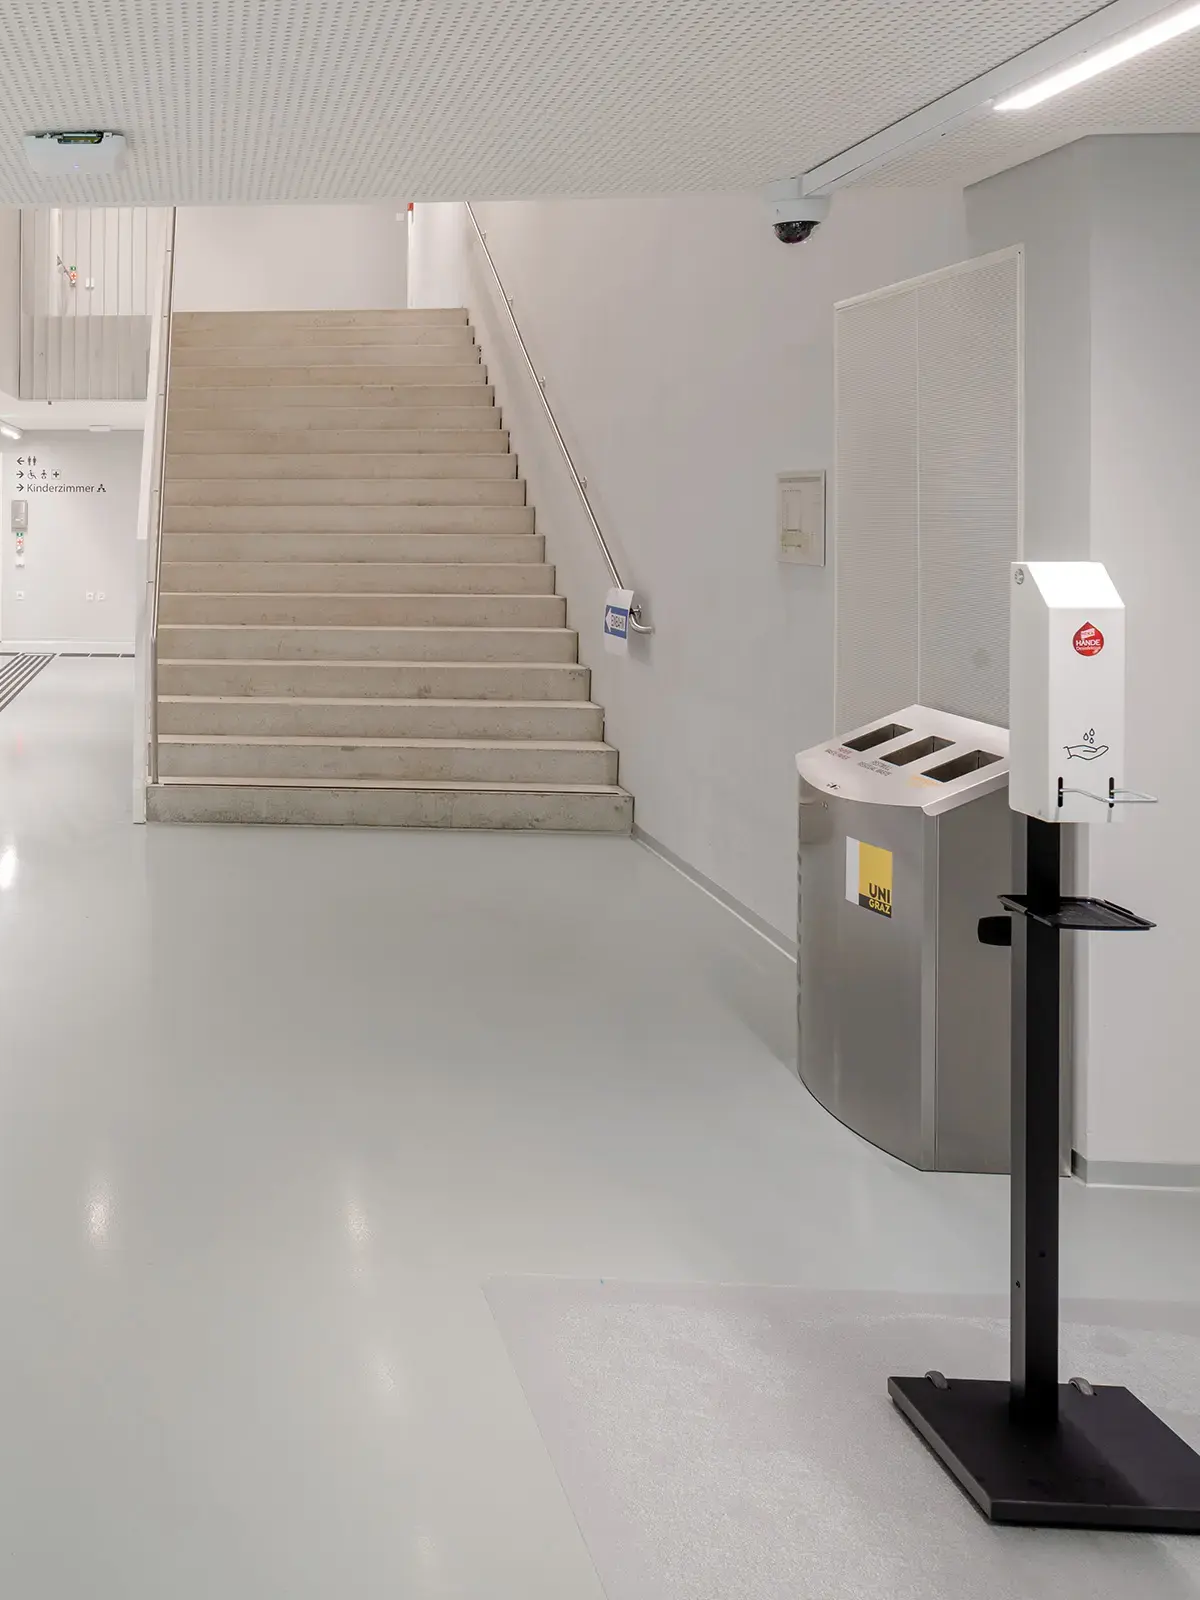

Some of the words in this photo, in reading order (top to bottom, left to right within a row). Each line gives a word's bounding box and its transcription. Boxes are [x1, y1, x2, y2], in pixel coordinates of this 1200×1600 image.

[26, 483, 95, 493] Kinderzimmer
[869, 882, 891, 904] UNI
[868, 898, 891, 915] GRAZ
